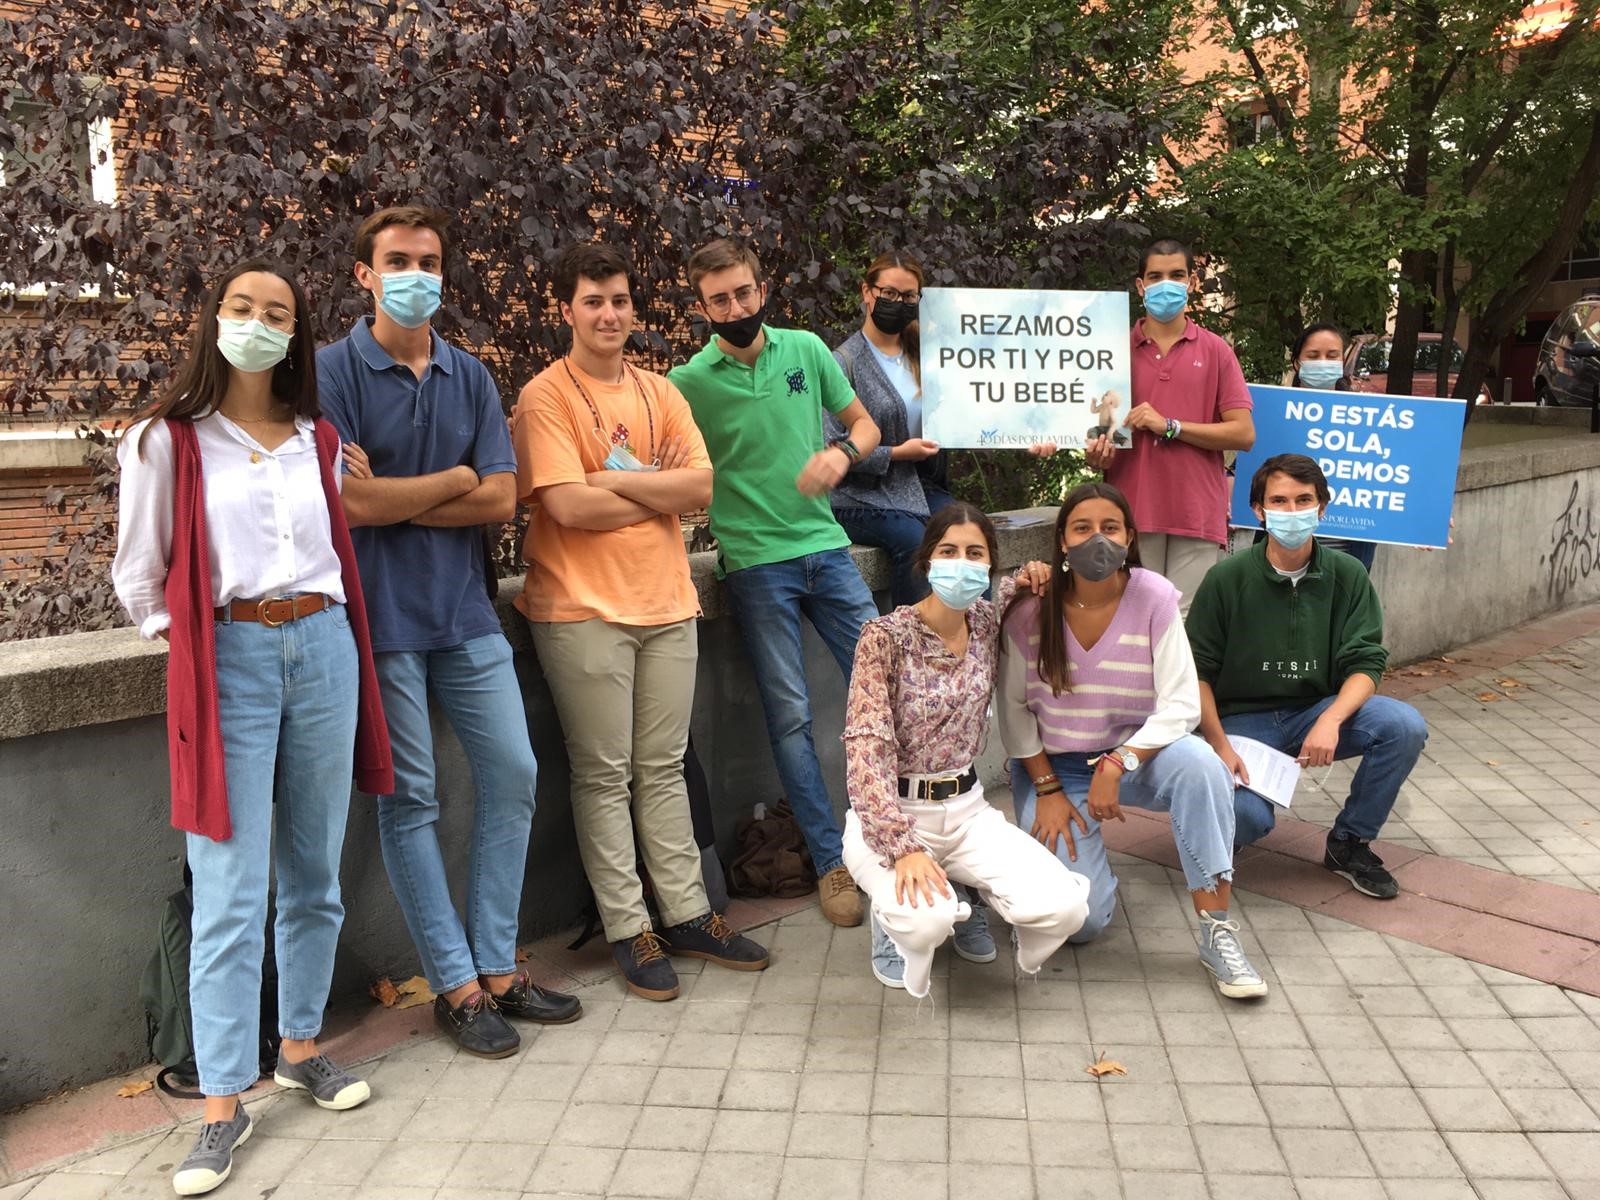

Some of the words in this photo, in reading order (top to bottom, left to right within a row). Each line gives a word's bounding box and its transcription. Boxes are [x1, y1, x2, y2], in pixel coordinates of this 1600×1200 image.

[960, 313, 1092, 337] REZAMOS
[939, 347, 996, 369] POR
[1003, 348, 1027, 370] TI
[1034, 348, 1051, 370] Y
[1059, 349, 1114, 371] POR
[969, 381, 1005, 403] TU
[1014, 377, 1085, 404] BEBÉ
[1285, 400, 1324, 422] NO
[1330, 403, 1416, 430] ESTÁS
[1305, 428, 1391, 459] SOLA,
[1318, 457, 1411, 485] DEMOS
